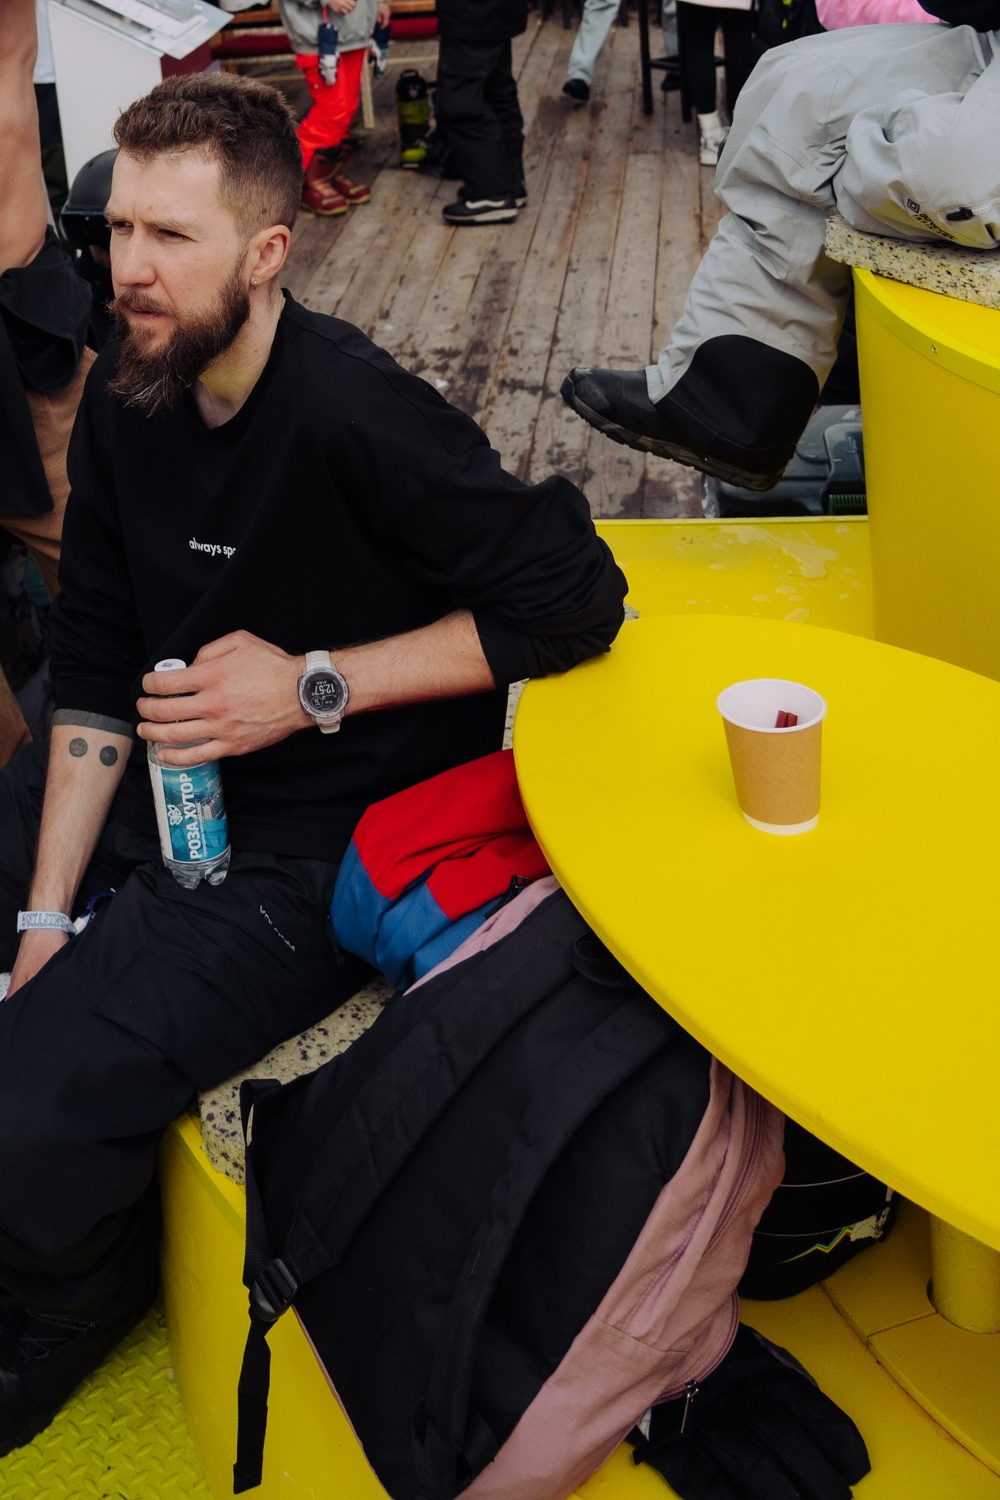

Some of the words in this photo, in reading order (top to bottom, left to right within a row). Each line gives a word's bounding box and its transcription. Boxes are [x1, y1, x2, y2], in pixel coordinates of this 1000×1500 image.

[189, 536, 222, 556] always
[314, 683, 336, 695] 12:57
[179, 772, 197, 821] ХУТОР
[185, 820, 203, 860] РОЗА
